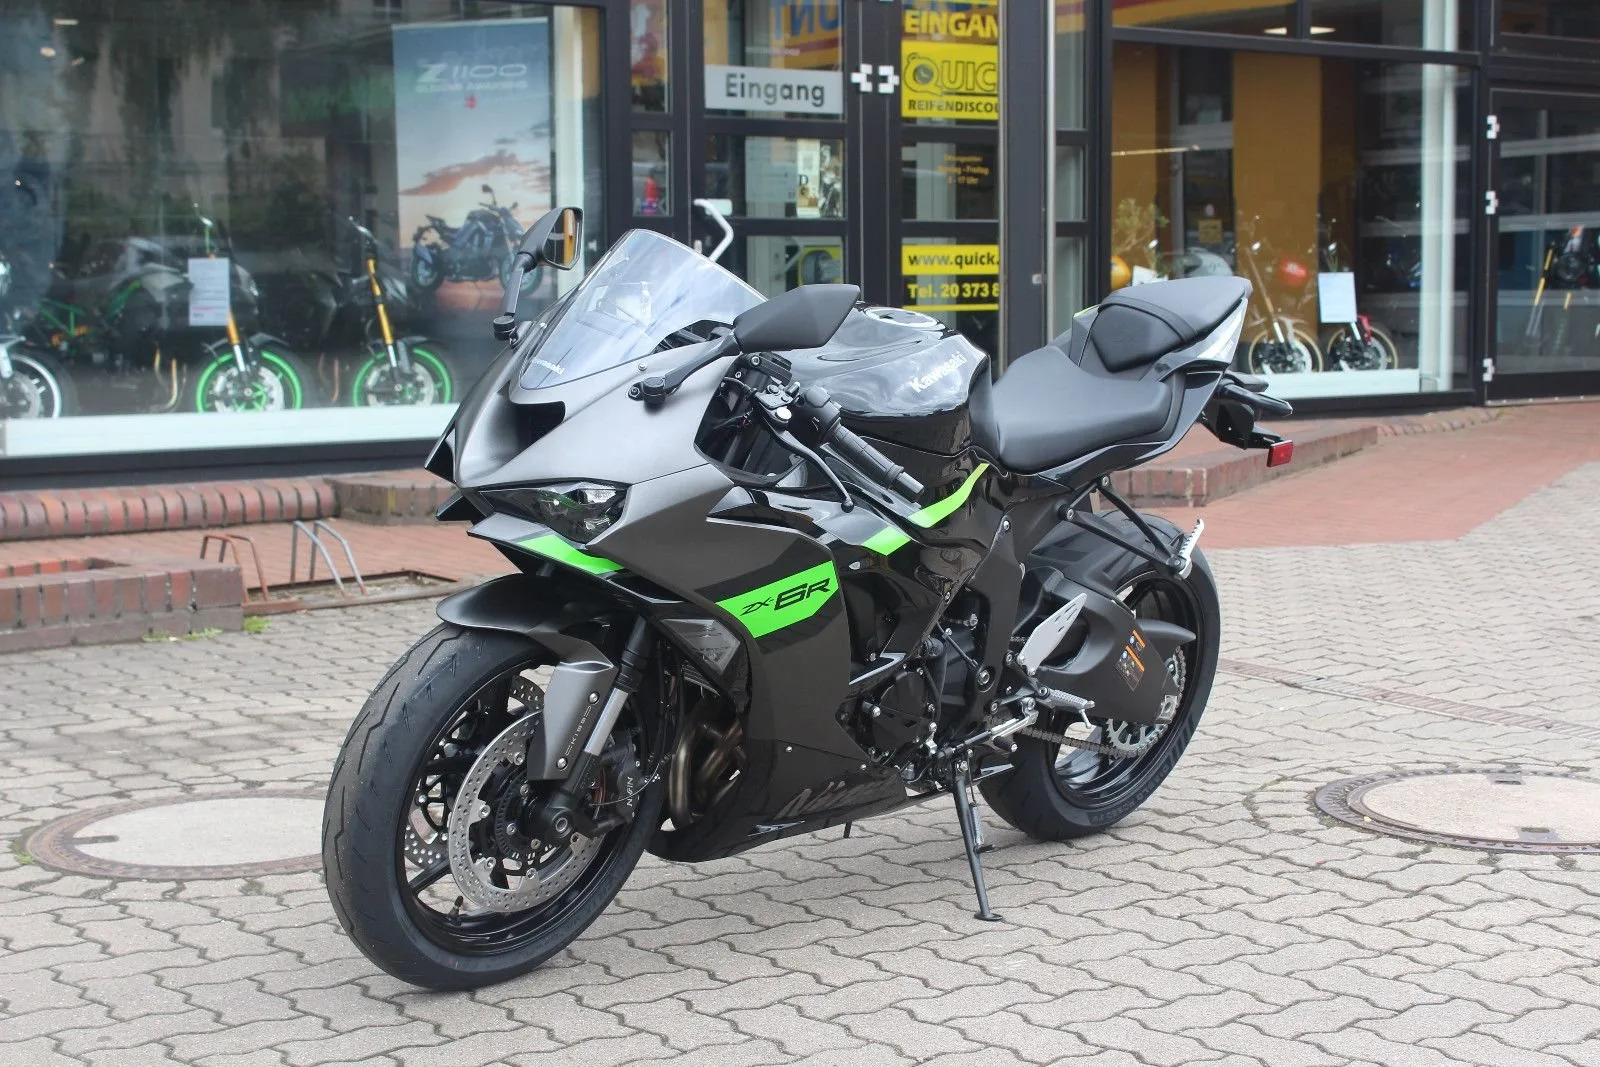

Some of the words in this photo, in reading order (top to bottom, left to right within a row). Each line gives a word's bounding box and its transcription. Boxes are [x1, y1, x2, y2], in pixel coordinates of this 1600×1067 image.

[726, 73, 825, 107] Eingang
[907, 284, 937, 299] Tel.
[941, 282, 960, 298] 20
[962, 282, 989, 298] 373
[908, 350, 968, 393] Kawasaki
